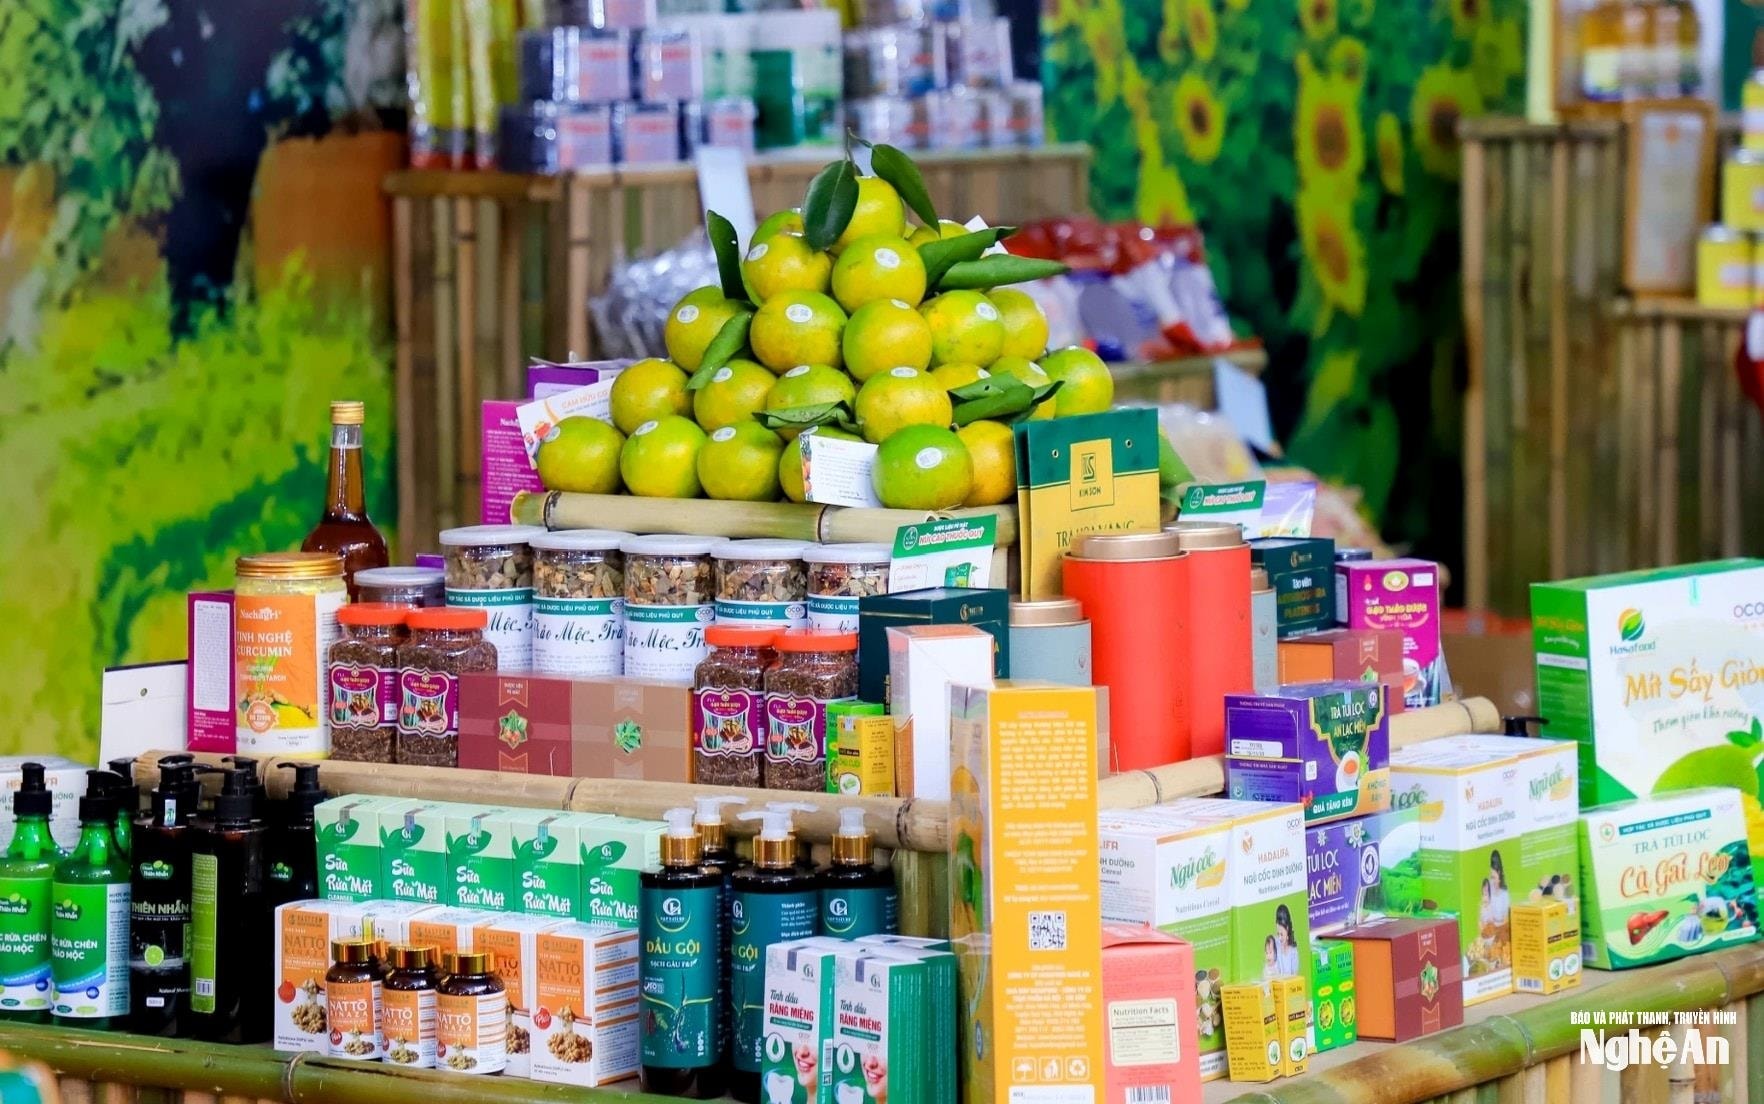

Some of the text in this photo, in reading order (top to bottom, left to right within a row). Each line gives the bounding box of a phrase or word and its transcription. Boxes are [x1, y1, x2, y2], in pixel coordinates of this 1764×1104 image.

[561, 604, 574, 612] LIỆU
[258, 630, 293, 645] NGHỆ
[1624, 656, 1764, 708] Mít Sấy Giò
[1352, 702, 1365, 718] LỌC
[1313, 801, 1324, 814] QUÀ
[325, 854, 348, 872] Sữa
[392, 858, 414, 876] Sữa
[1308, 849, 1339, 873] TÚI LỌC
[456, 866, 480, 884] Sữa
[522, 870, 546, 890] Sữa
[1258, 868, 1271, 882] CỐC
[1620, 865, 1650, 898] Cà
[1696, 852, 1730, 884] Leo
[326, 874, 372, 896] Rửa Mặt
[392, 880, 438, 902] Rửa Mặt
[590, 877, 614, 896] Sữa
[1309, 880, 1322, 905] ẠC
[132, 900, 156, 914] THIÊN
[457, 886, 504, 910] Rửa Mặt
[522, 891, 572, 916] Rửa Mặt
[590, 898, 638, 922] Rửa Mặt
[4, 932, 47, 942] RỬA CHÉN
[74, 939, 98, 950] CHÉN
[13, 944, 34, 955] MỘC
[66, 950, 84, 962] MỘC
[675, 939, 700, 957] GỘI
[738, 944, 758, 962] GỘI
[1113, 1006, 1169, 1018] Nutrition Facts
